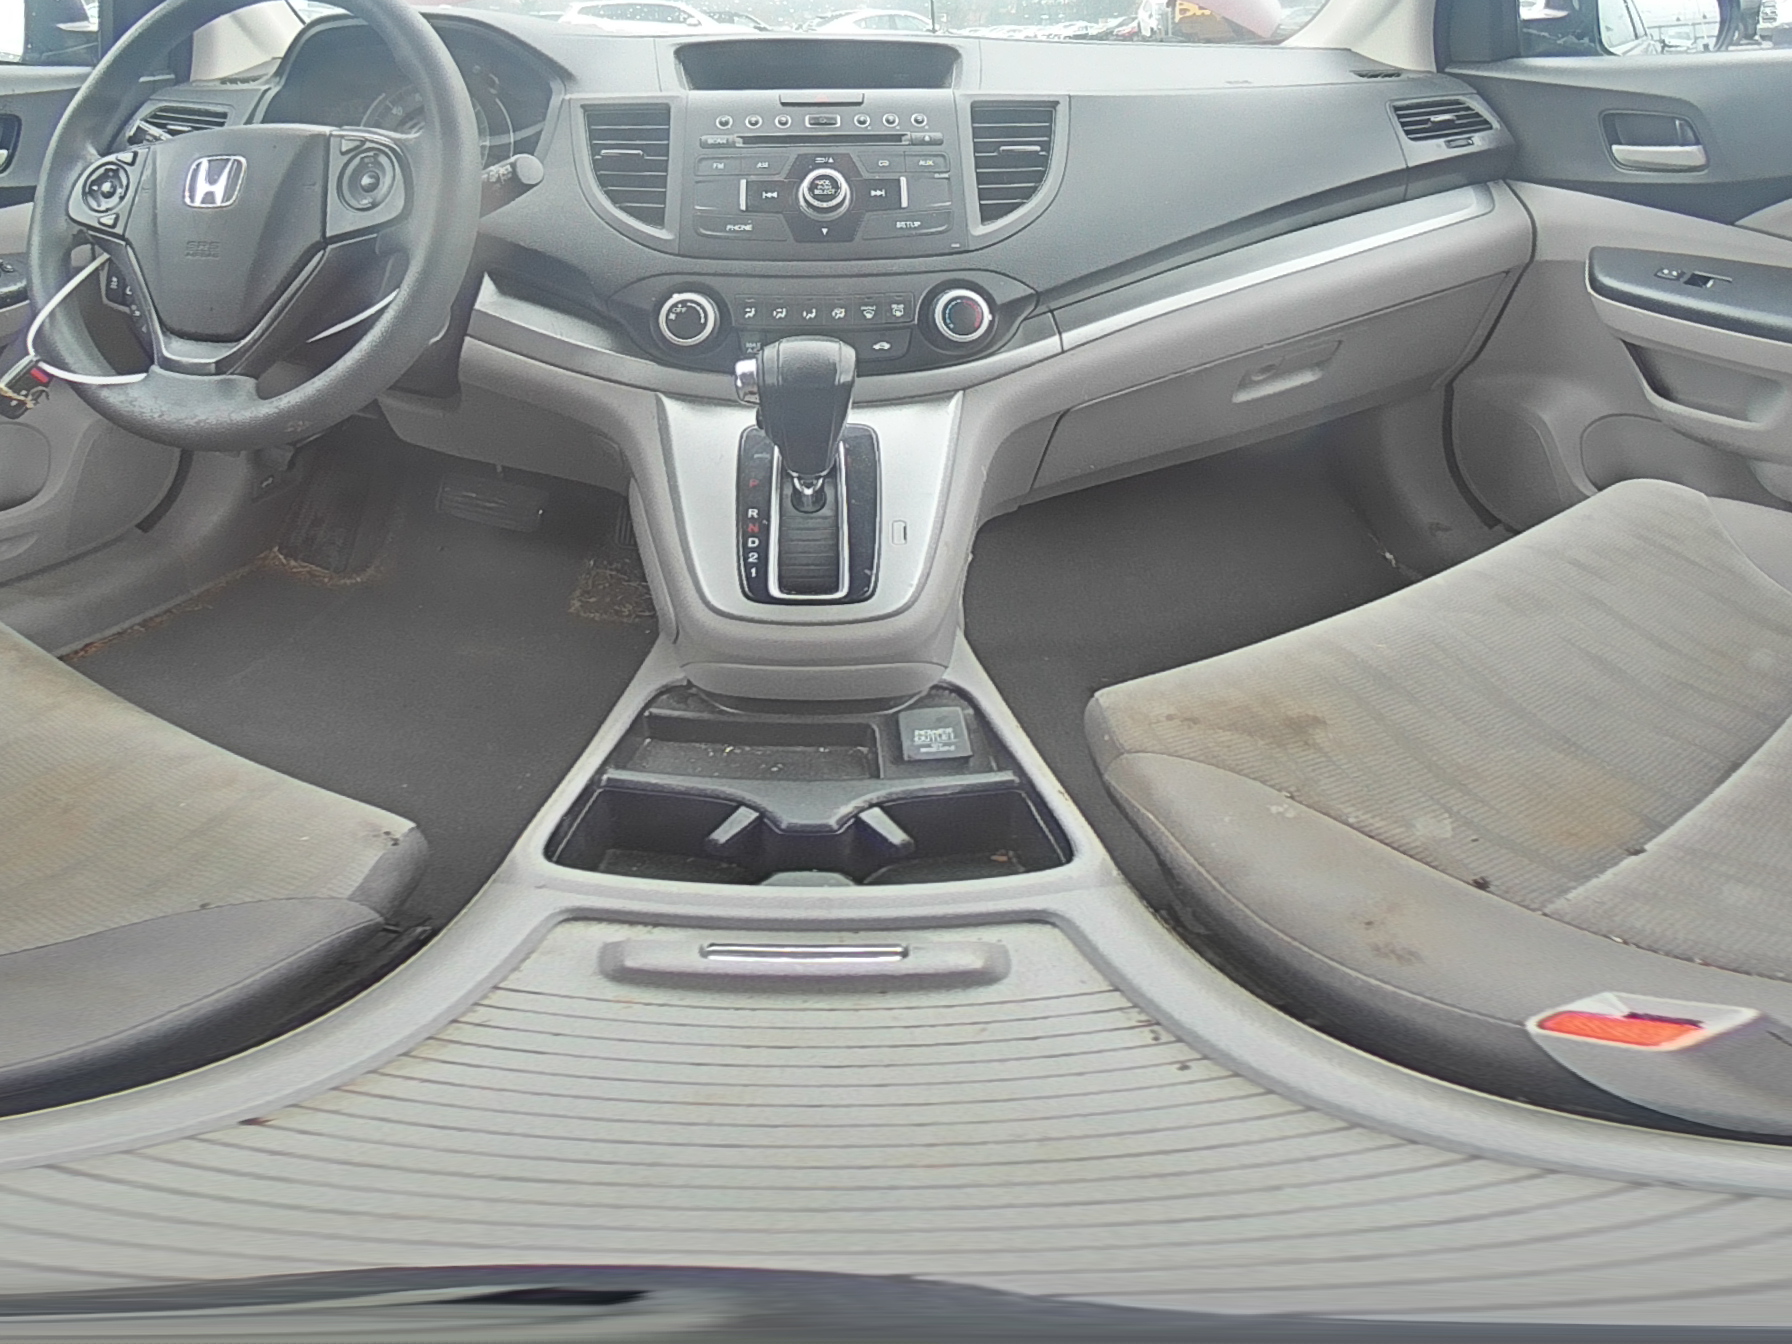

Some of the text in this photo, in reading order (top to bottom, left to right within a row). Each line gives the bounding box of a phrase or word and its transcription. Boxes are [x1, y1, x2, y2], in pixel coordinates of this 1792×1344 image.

[749, 479, 759, 488] P
[748, 508, 759, 518] R
[748, 523, 759, 533] N
[748, 538, 759, 547] D
[748, 552, 759, 562] 2
[750, 567, 757, 577] 1
